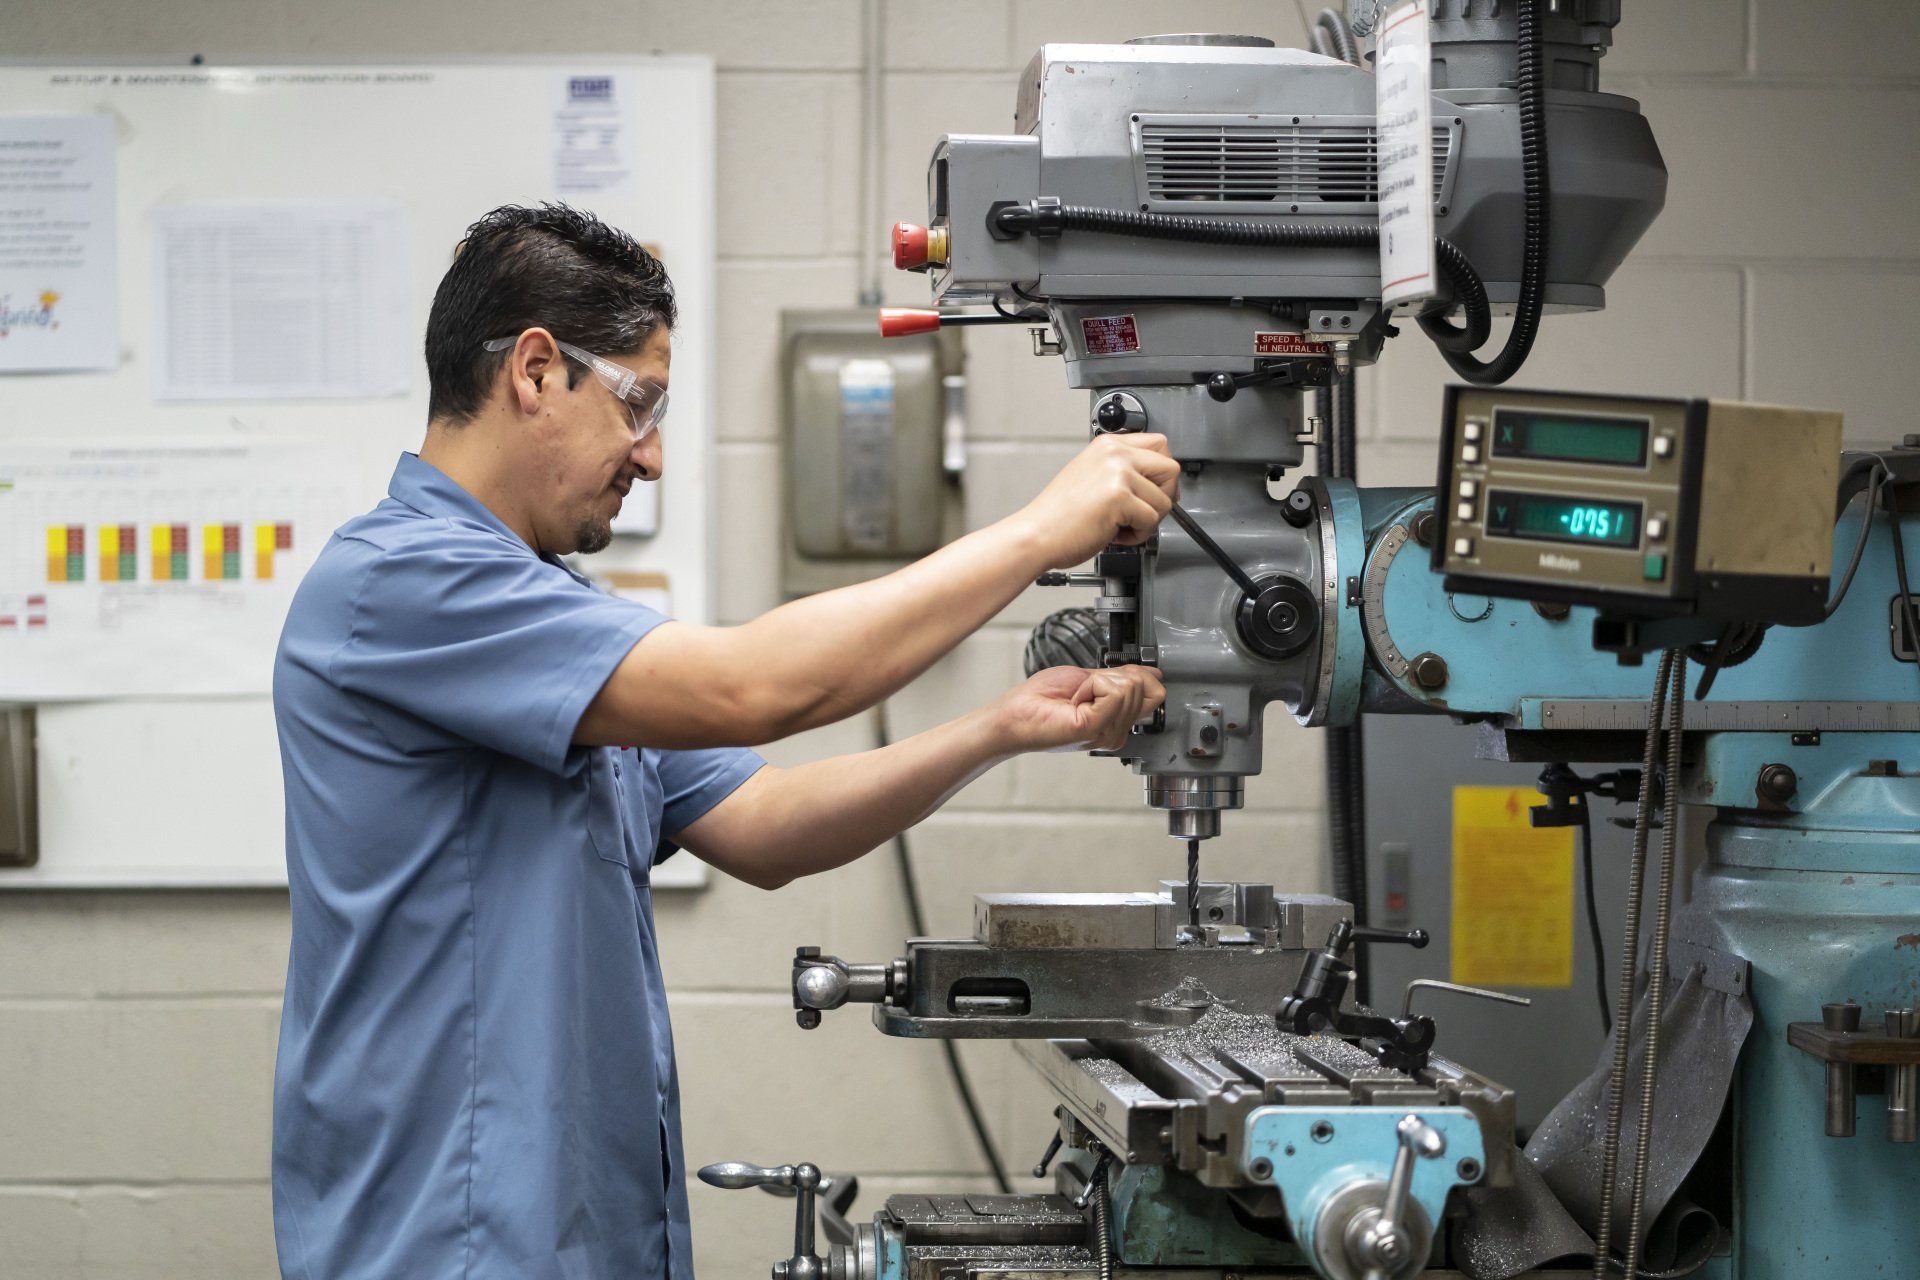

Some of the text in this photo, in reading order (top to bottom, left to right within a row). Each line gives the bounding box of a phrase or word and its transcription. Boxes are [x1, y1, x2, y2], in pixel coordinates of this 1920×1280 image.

[1108, 318, 1126, 326] FEED
[1502, 425, 1514, 443] X
[1496, 506, 1507, 522] Y
